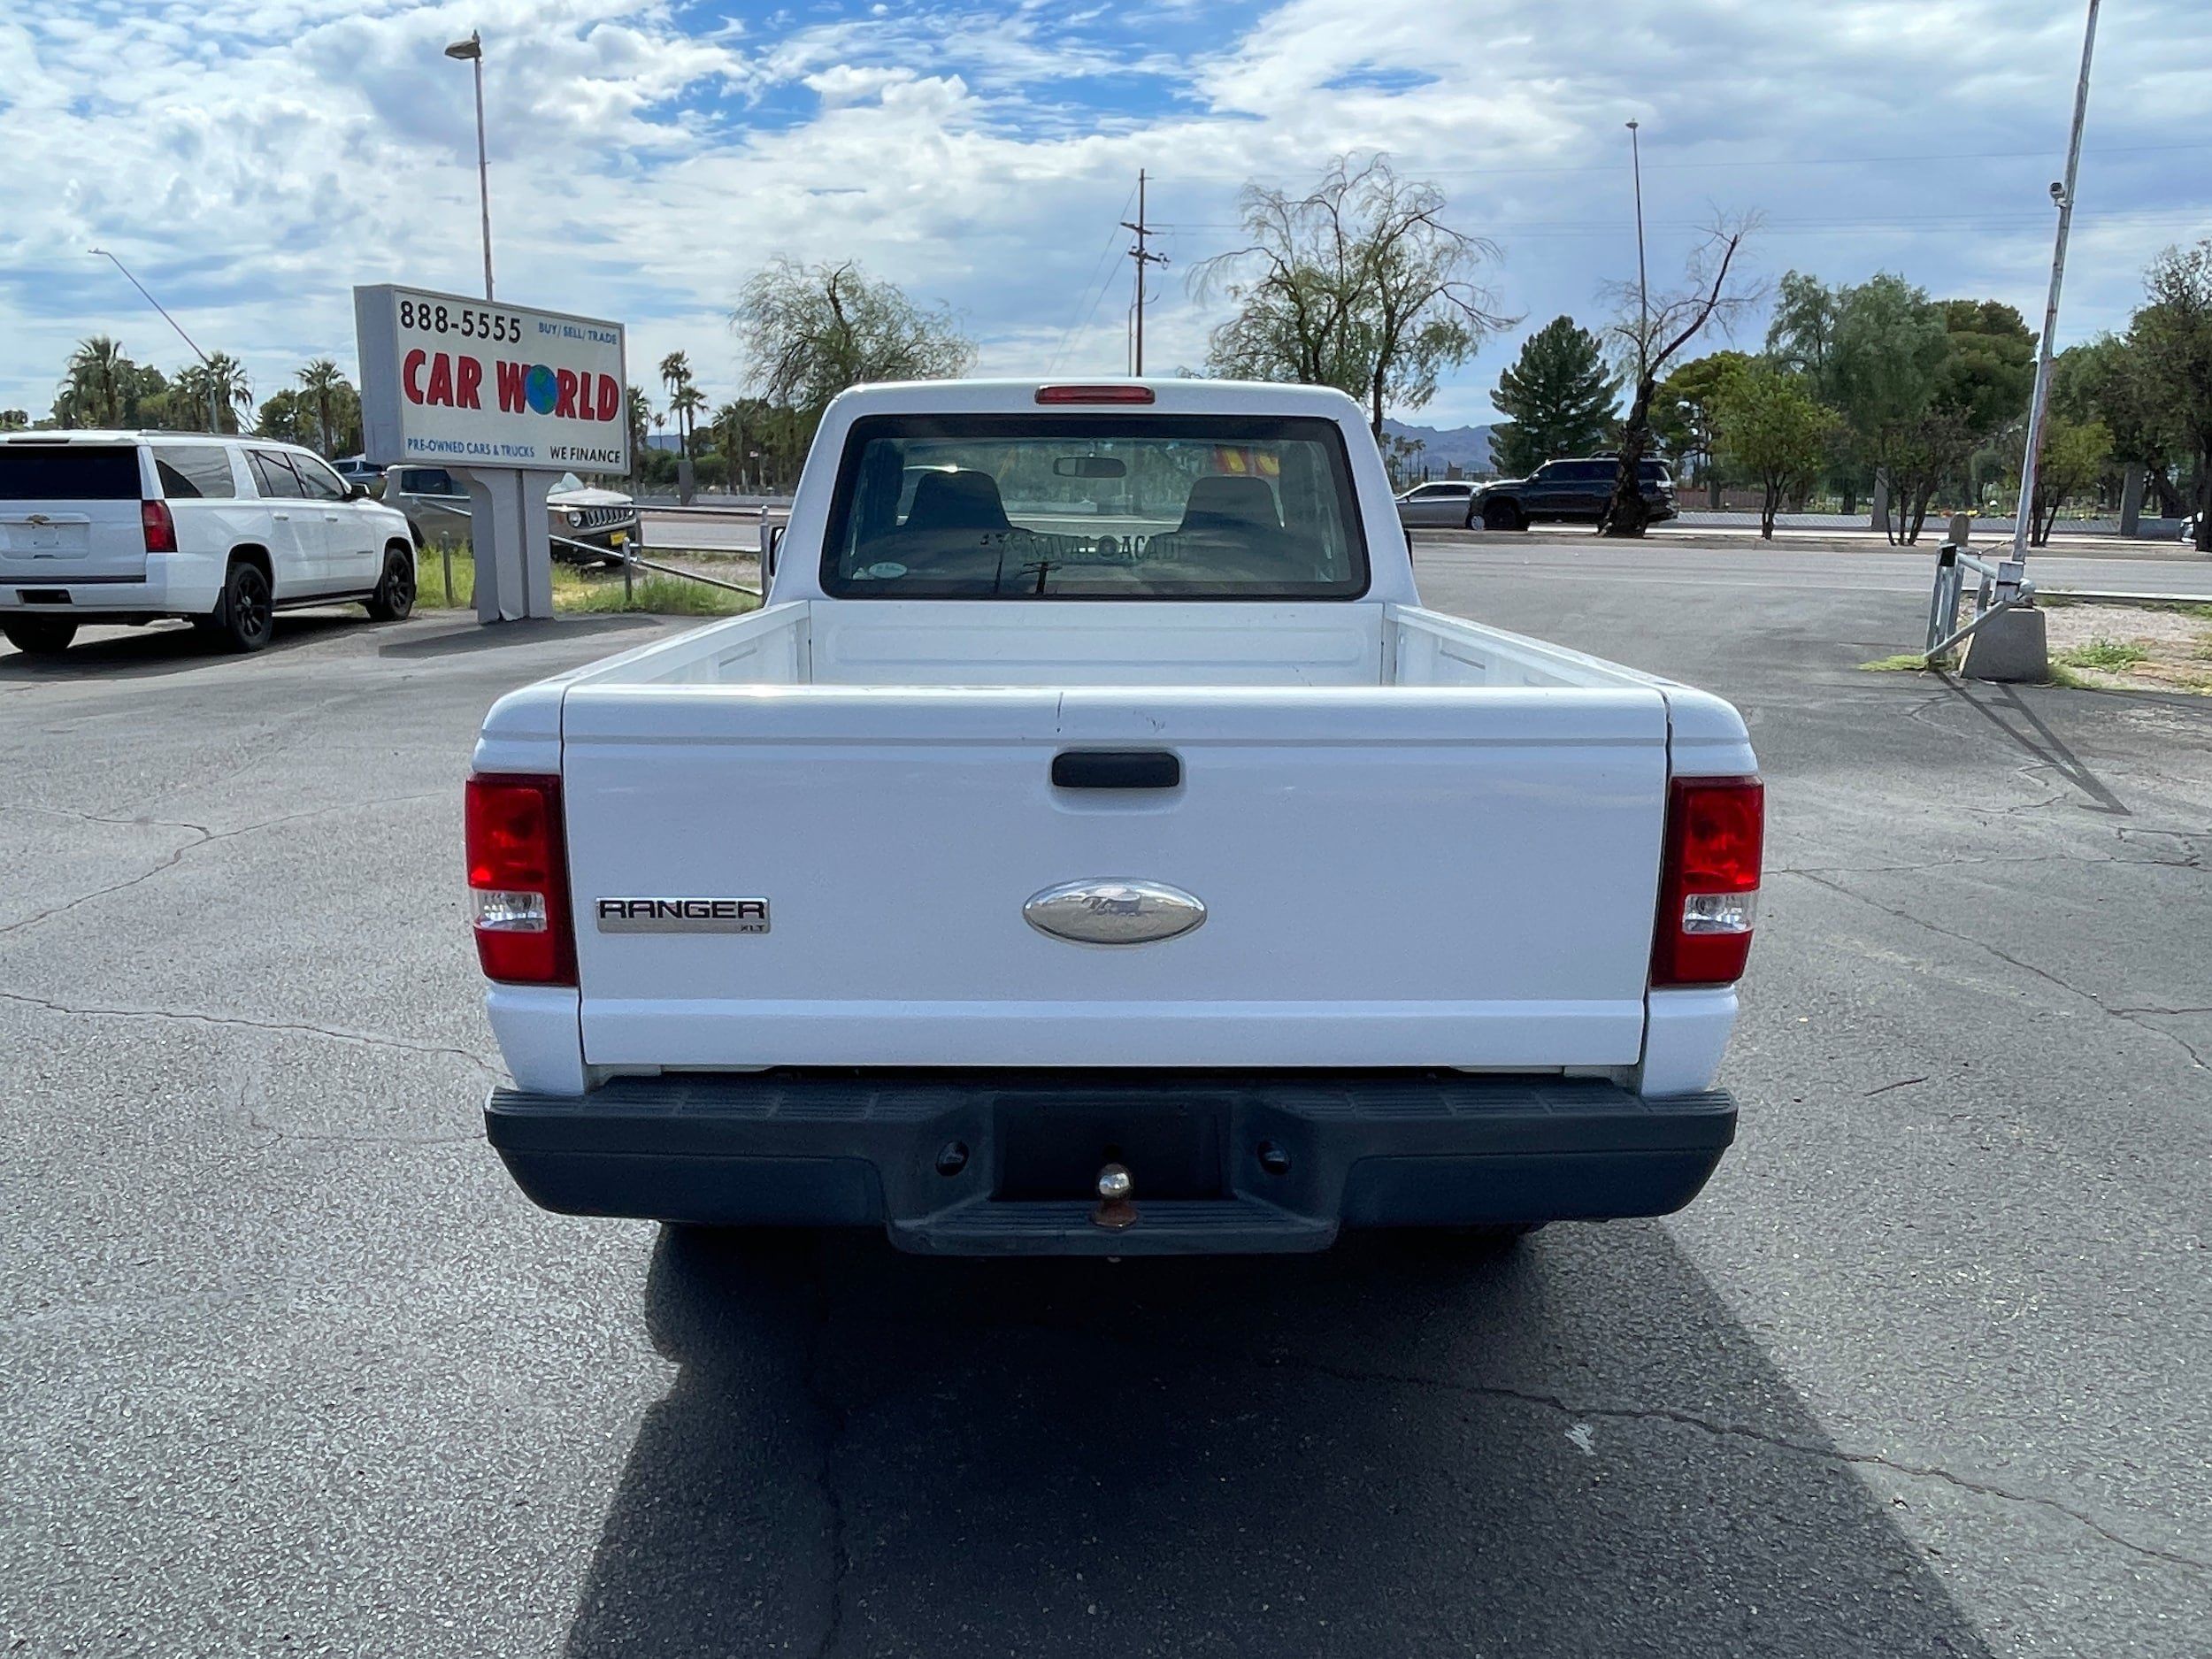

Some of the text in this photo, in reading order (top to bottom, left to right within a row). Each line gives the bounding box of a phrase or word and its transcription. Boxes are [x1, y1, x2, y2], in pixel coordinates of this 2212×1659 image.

[401, 300, 521, 343] 888-5555
[588, 330, 618, 345] TRADE
[403, 349, 620, 422] CAR WORLD
[407, 438, 534, 457] PRE-OWNED CARS & TRUCKS
[549, 445, 621, 463] WE FINANCE
[599, 900, 765, 919] RANGER
